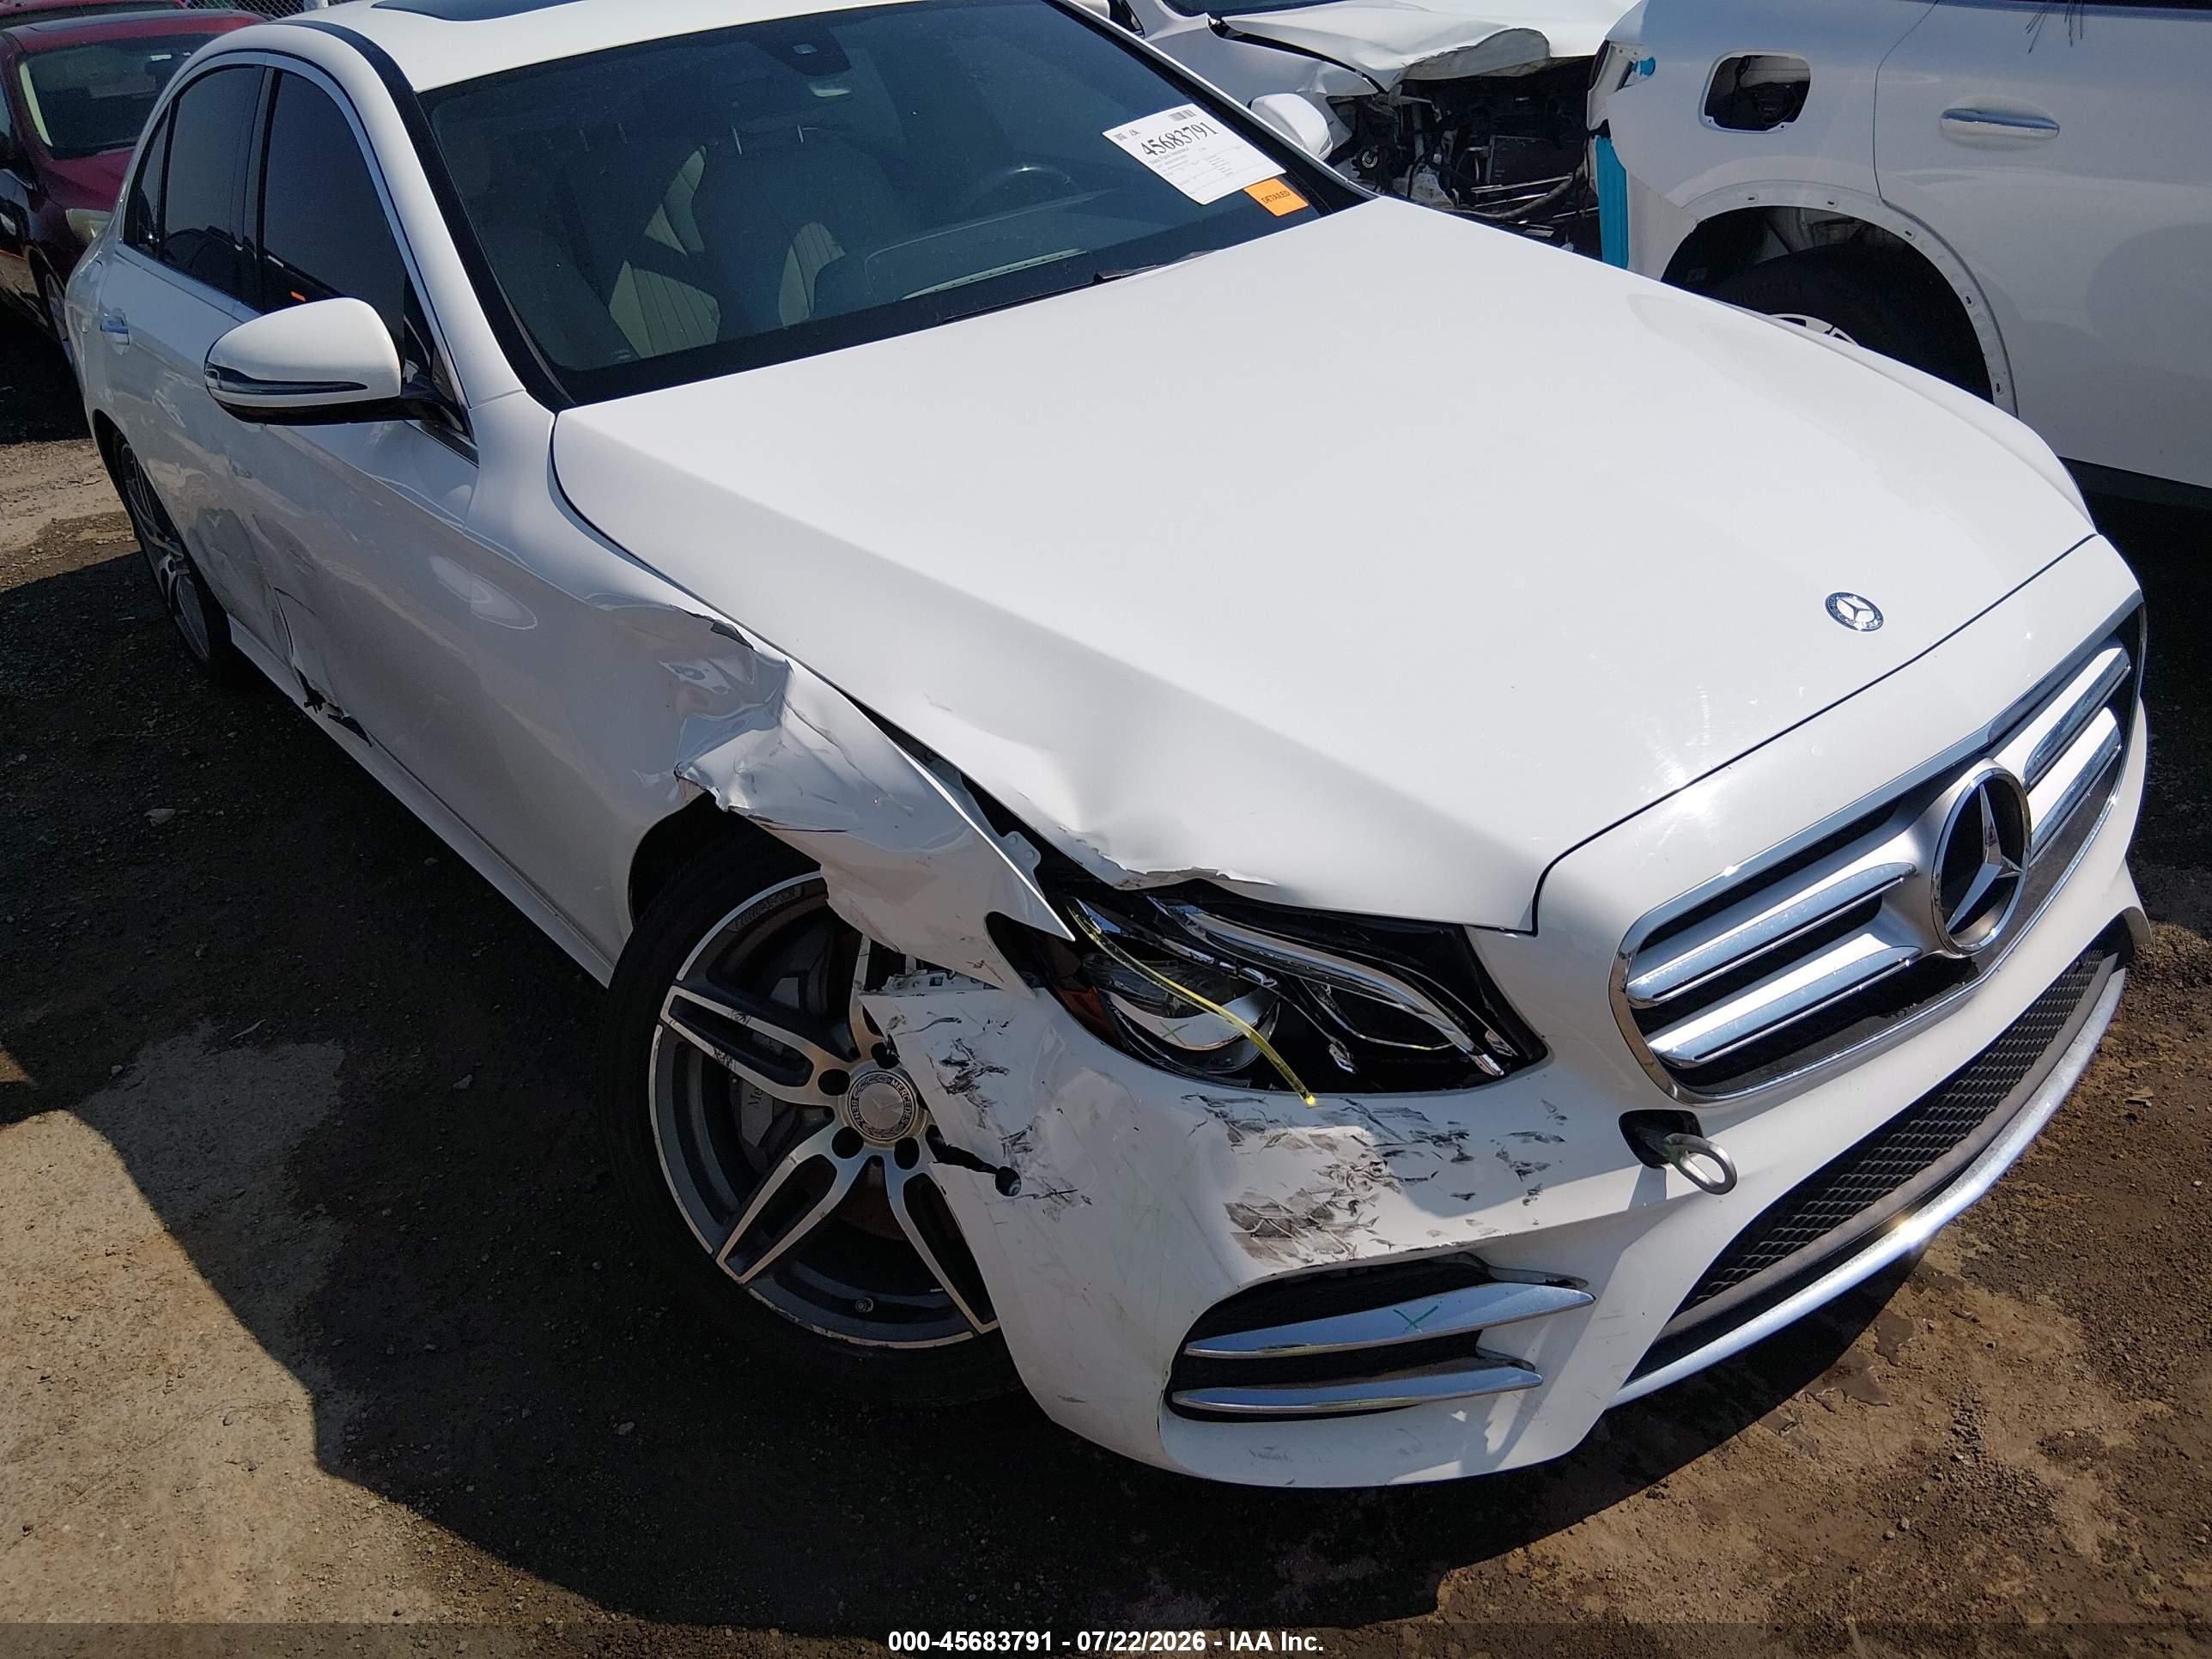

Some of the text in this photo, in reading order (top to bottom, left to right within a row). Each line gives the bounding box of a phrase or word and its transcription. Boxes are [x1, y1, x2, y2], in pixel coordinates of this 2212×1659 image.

[1141, 122, 1218, 155] 45683791
[851, 1099, 864, 1125] BENZ
[890, 1079, 912, 1125] MERCEDES
